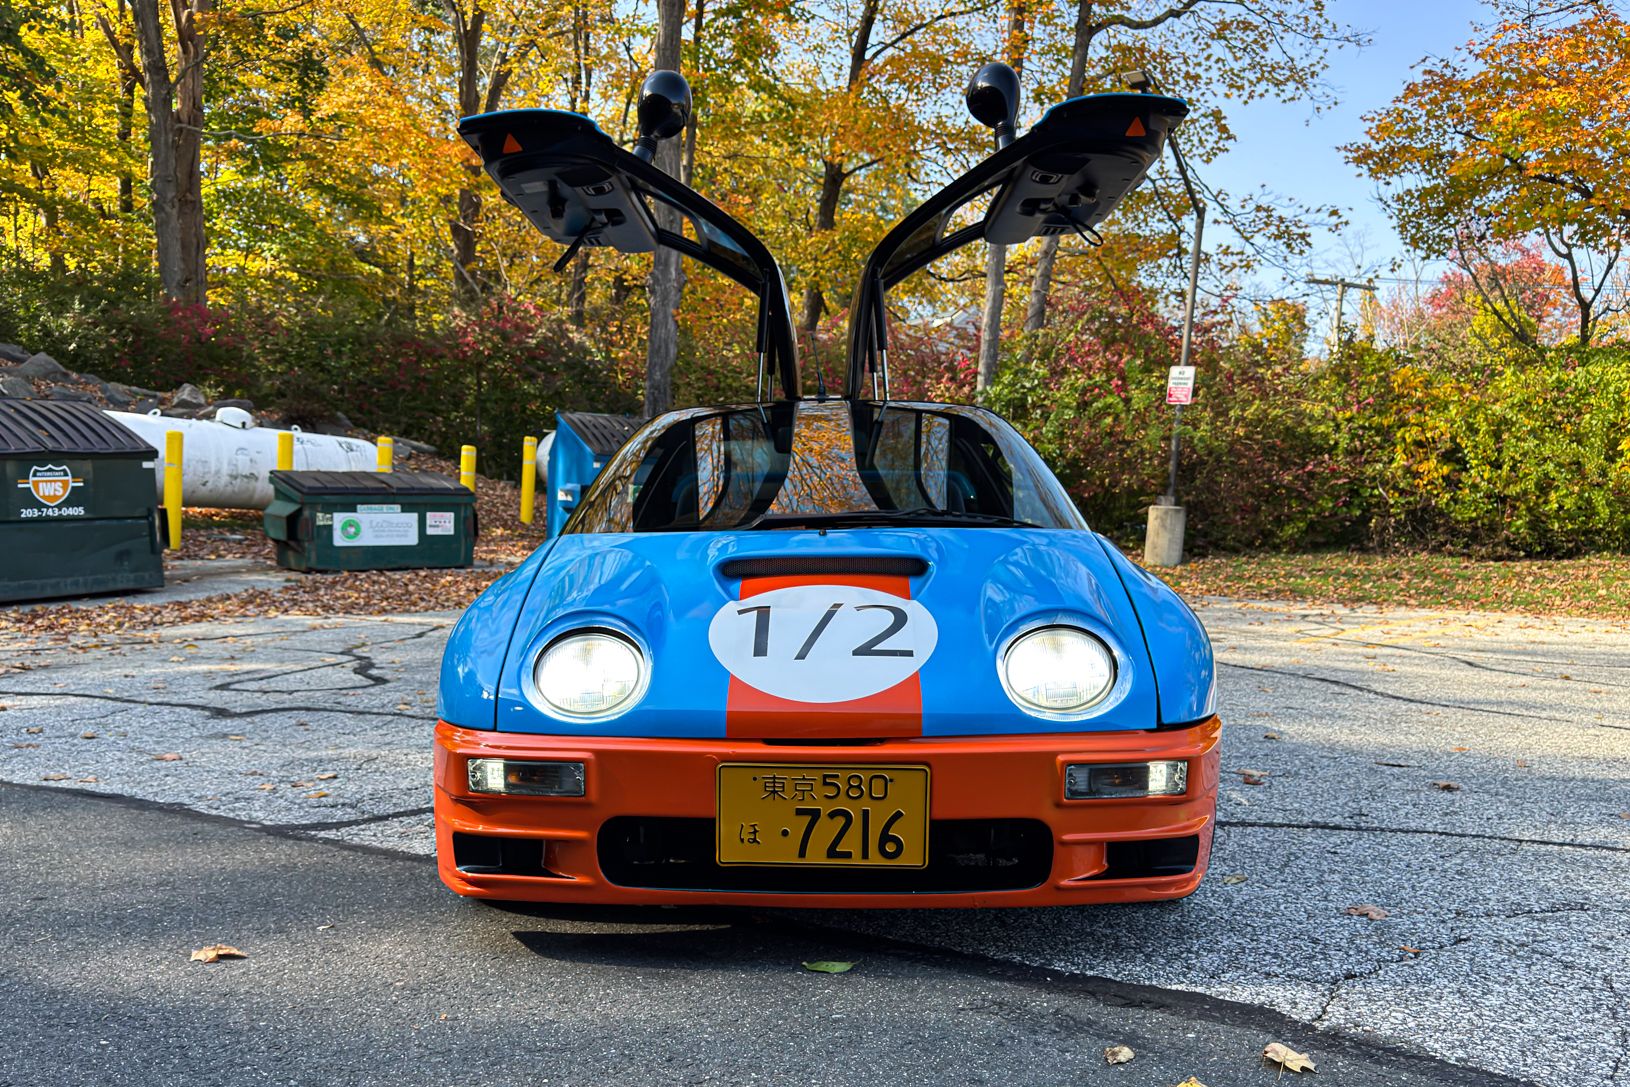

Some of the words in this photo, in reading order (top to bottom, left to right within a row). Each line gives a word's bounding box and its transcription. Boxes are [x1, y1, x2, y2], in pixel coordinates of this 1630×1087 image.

[38, 482, 63, 496] IWS
[20, 507, 85, 518] 203-743-0405
[736, 602, 915, 661] 1/2
[739, 823, 762, 845] ほ
